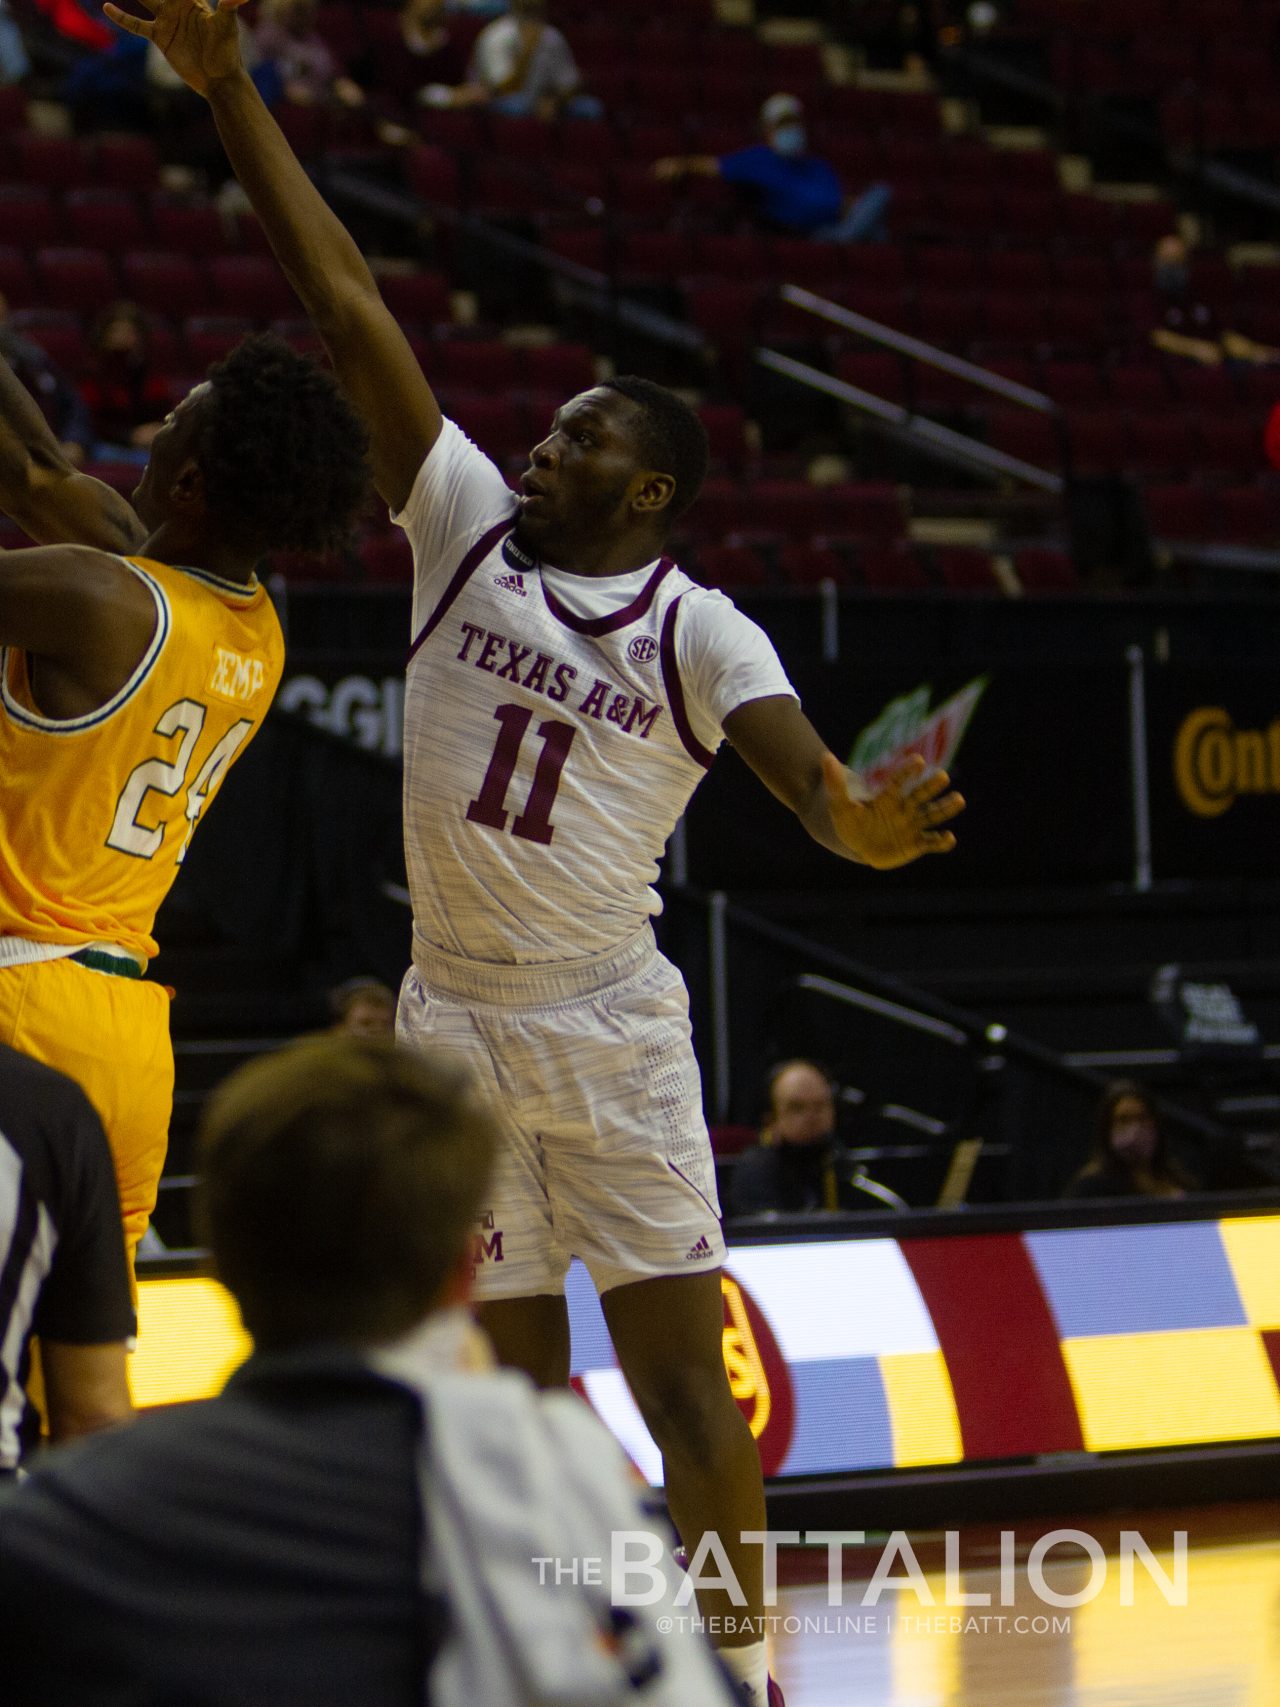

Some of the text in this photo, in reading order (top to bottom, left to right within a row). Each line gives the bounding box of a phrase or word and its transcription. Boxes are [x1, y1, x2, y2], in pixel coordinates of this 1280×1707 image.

[494, 573, 527, 597] adidas
[457, 622, 664, 738] TEXAS A&M
[631, 636, 656, 660] SEC
[105, 698, 255, 866] 24
[466, 703, 577, 845] 11
